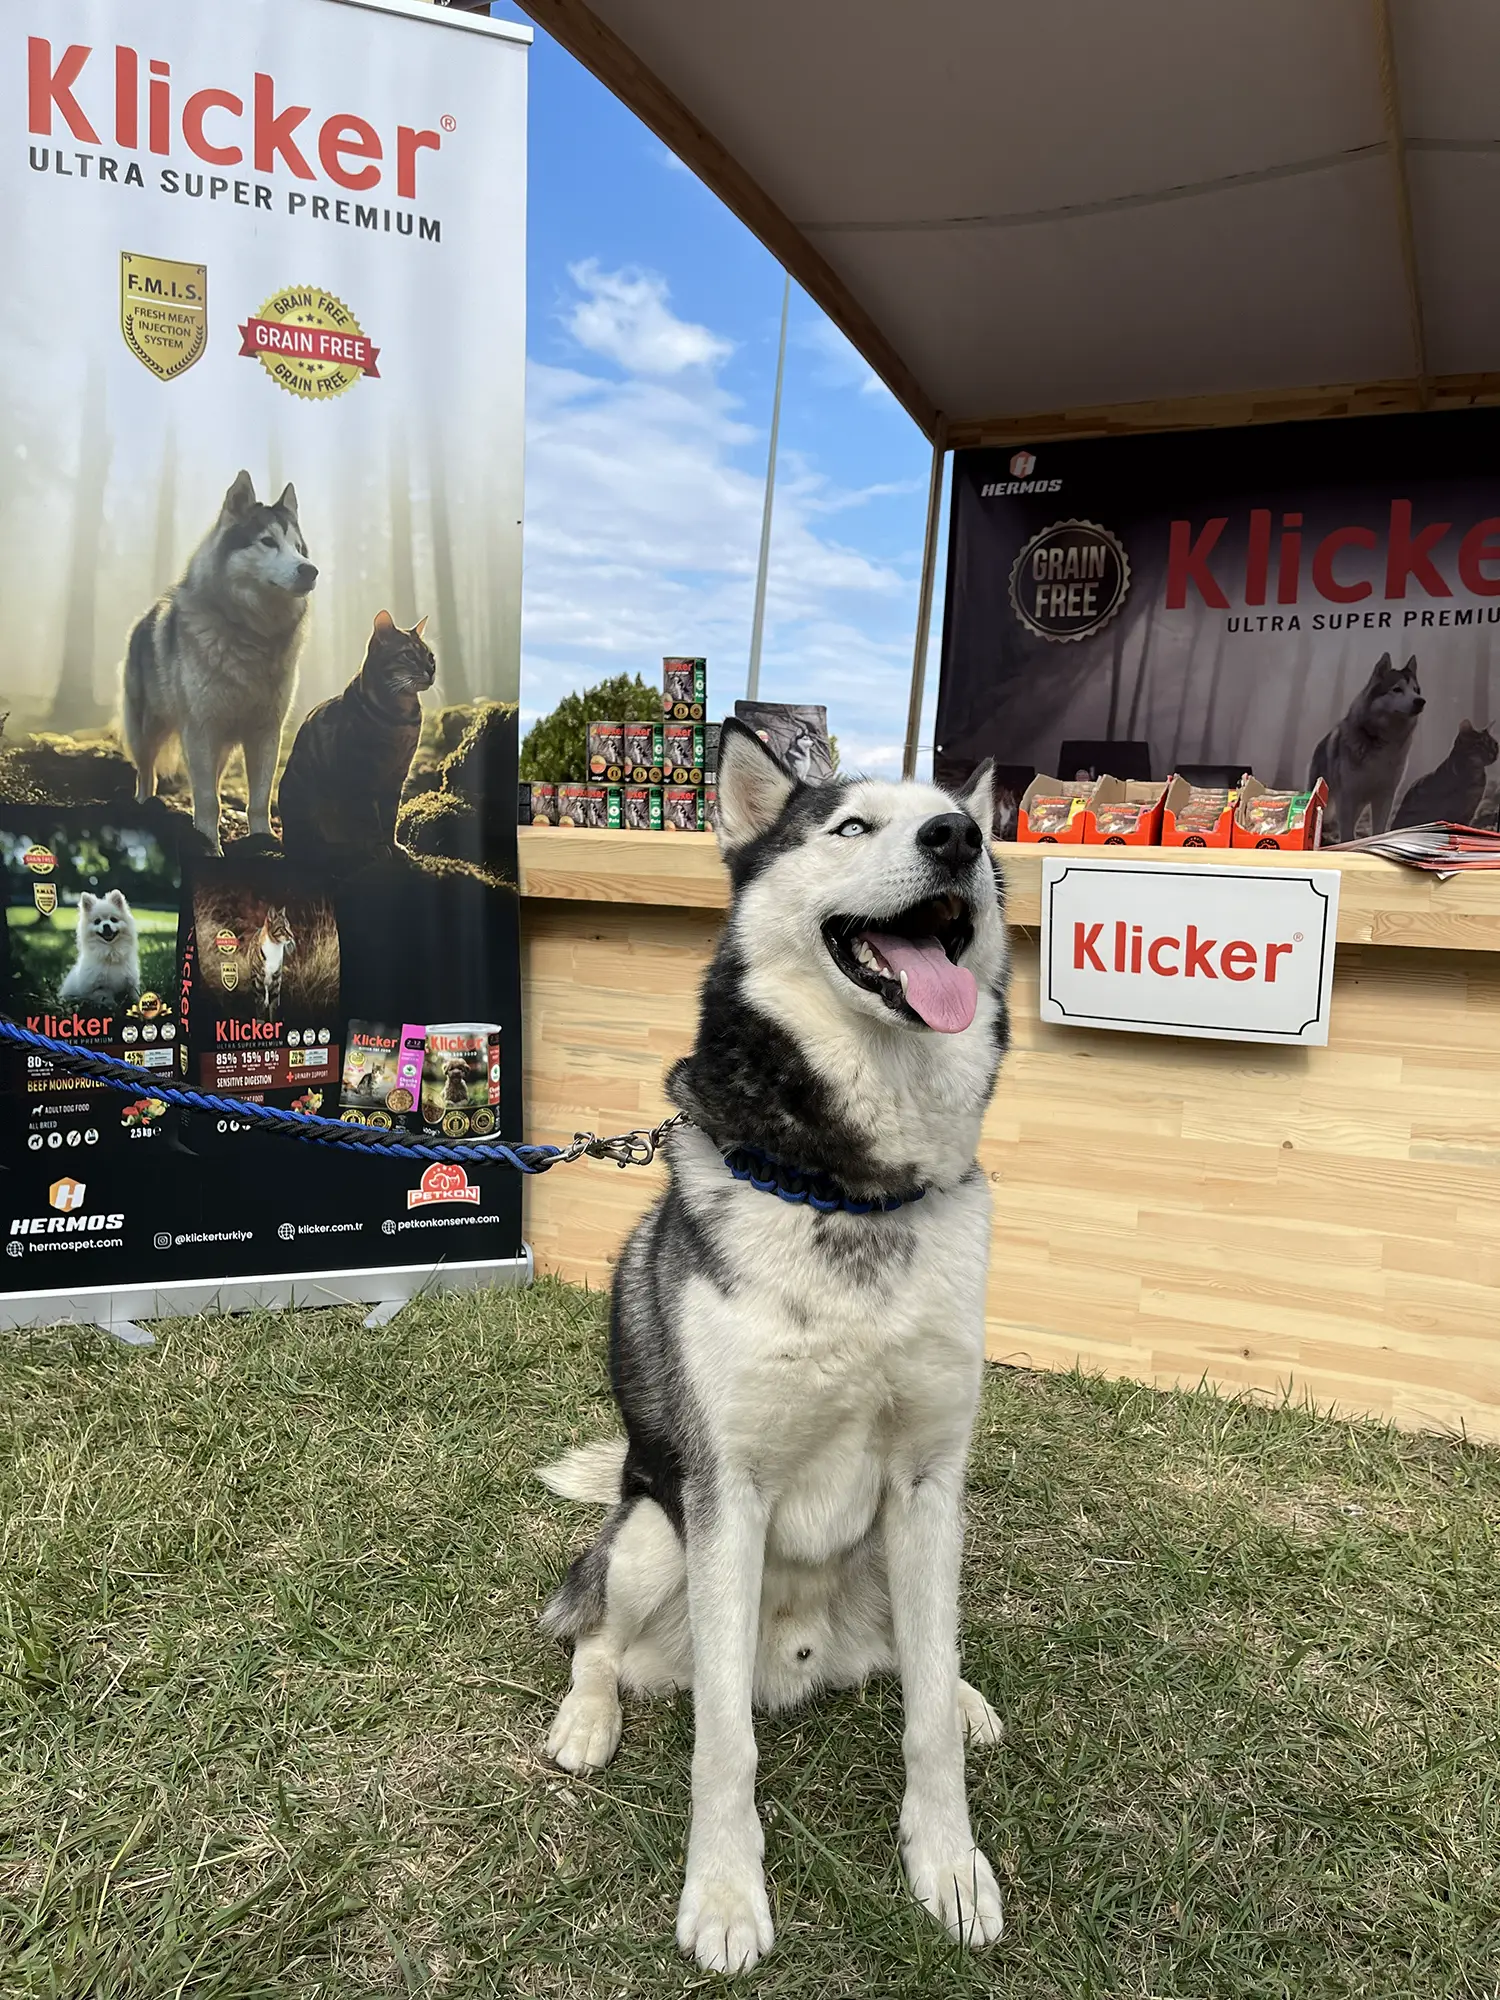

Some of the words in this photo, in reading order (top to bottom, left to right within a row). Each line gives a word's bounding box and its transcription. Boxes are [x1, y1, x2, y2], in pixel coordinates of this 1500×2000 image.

[29, 146, 144, 188] ULTRA
[160, 169, 272, 210] SUPER
[289, 192, 442, 243] PREMIUM
[128, 273, 203, 301] F.M.I.S.
[134, 306, 166, 320] FRESH
[168, 313, 195, 325] MEAT
[274, 293, 312, 314] GRAIN
[317, 296, 349, 327] FREE
[138, 321, 191, 336] INJECTION
[144, 335, 184, 349] SYSTEM
[256, 325, 312, 352] GRAIN
[320, 335, 365, 361] FREE
[274, 363, 312, 391] GRAIN
[317, 371, 348, 392] FREE
[981, 479, 1063, 497] HERMOS
[1032, 545, 1106, 581] GRAIN
[1035, 582, 1099, 618] FREE
[1227, 615, 1301, 633] ULTRA
[1312, 612, 1391, 630] SUPER
[180, 925, 194, 1033] licker
[27, 1013, 113, 1038] Klicker
[216, 1018, 283, 1042] Klicker
[353, 1034, 398, 1048] Klicker
[127, 1052, 143, 1060] 45%
[216, 1052, 237, 1065] 85%
[241, 1051, 261, 1063] 15%
[265, 1050, 279, 1062] 0%
[27, 1080, 48, 1092] BEEF
[49, 1078, 74, 1090] MONO
[75, 1076, 108, 1089] PROTE
[217, 1076, 243, 1088] SENSITIVE
[244, 1074, 272, 1086] DIGESTION
[44, 1106, 62, 1114] ADULT
[75, 1103, 90, 1112] FOOD
[28, 1122, 39, 1130] ALL
[411, 1188, 477, 1203] PETKON
[10, 1214, 125, 1235] HERMOS
[298, 1221, 364, 1235] klicker.com.tr
[398, 1214, 500, 1232] petkonkonserve.com
[29, 1237, 123, 1252] hermospet.com
[175, 1229, 253, 1246] @klickerturkiye
